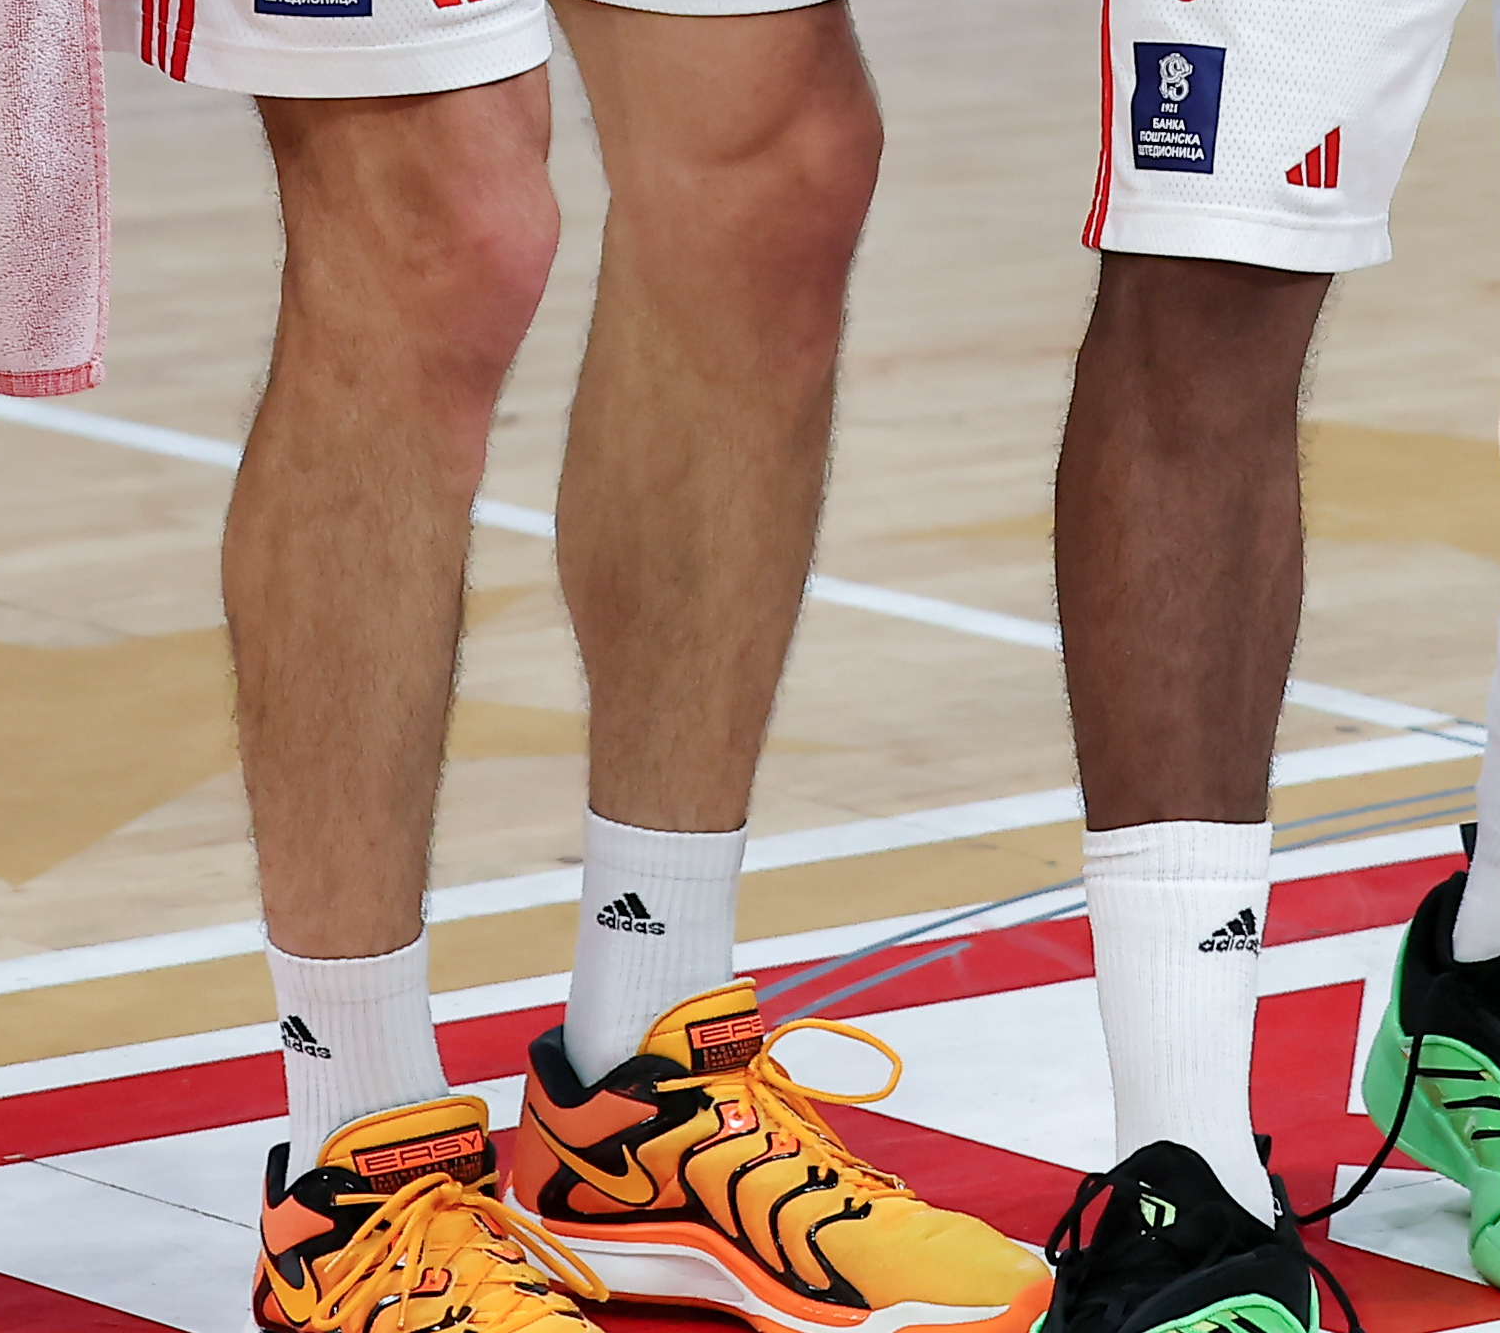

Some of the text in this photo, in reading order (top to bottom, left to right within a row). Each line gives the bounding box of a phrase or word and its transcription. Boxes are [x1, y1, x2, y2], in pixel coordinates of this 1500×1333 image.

[1160, 102, 1179, 114] 1921
[1152, 117, 1186, 131] БАНКА
[1139, 130, 1201, 146] ПОШТАНСКА
[1137, 144, 1205, 161] ШТЕДИОНИЦА
[596, 913, 665, 935] adidas
[364, 1132, 479, 1172] EASY
